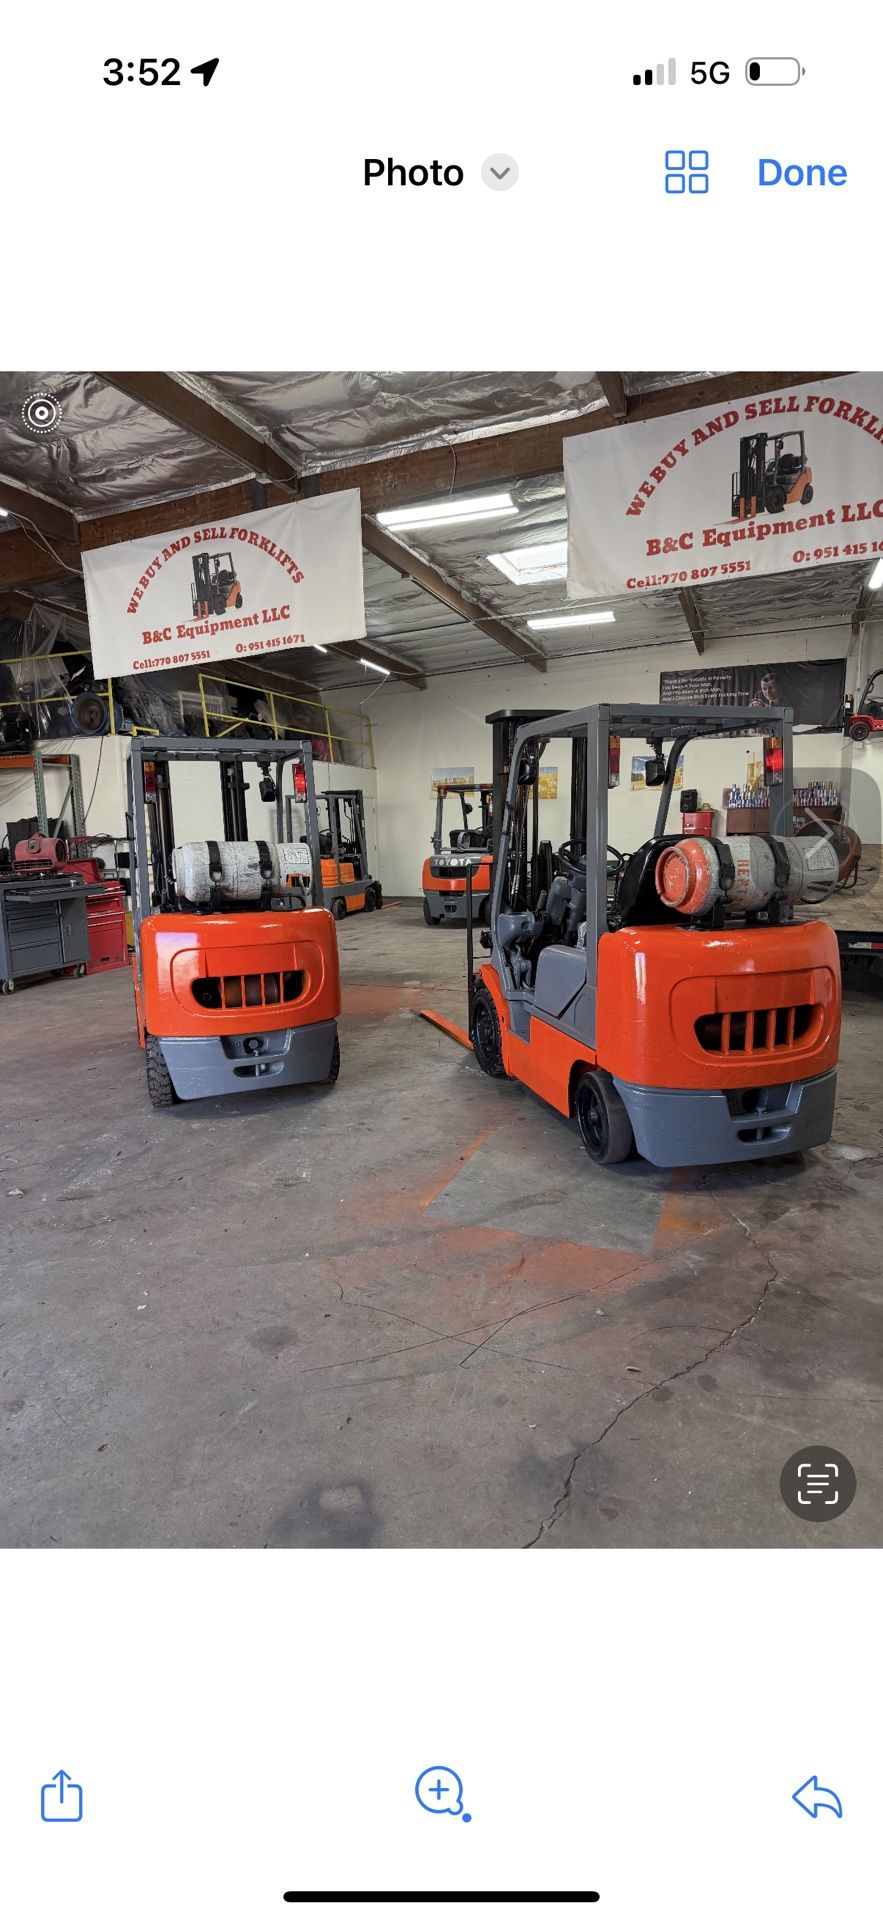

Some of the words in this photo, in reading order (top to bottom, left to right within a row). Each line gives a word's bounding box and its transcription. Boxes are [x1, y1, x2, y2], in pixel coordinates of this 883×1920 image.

[626, 481, 656, 517] WE
[650, 439, 690, 483] BUY
[692, 410, 740, 446] AND
[745, 396, 800, 420] SELL
[803, 395, 883, 445] FORKLI
[646, 531, 694, 557] B&C
[703, 510, 836, 548] Equipment
[842, 498, 883, 523] LLC
[792, 549, 811, 564] O:
[814, 546, 840, 560] 951
[843, 543, 867, 556] 415
[127, 588, 144, 615] WE
[141, 556, 164, 588] BUY
[162, 536, 192, 562] AND
[194, 527, 227, 544] SELL
[229, 527, 305, 584] FORKLIFTS
[626, 571, 688, 590] Cell:770
[691, 565, 718, 581] 807
[721, 560, 751, 576] 5551
[142, 626, 172, 645] B&C
[177, 612, 260, 641] Equipment
[261, 604, 291, 625] LLC
[235, 643, 248, 653] O:
[248, 641, 265, 652] 951
[265, 637, 281, 649] 415
[282, 633, 305, 647] 1671
[172, 653, 190, 667] 807
[191, 650, 211, 662] 5551
[435, 858, 472, 866] TOYOTA
